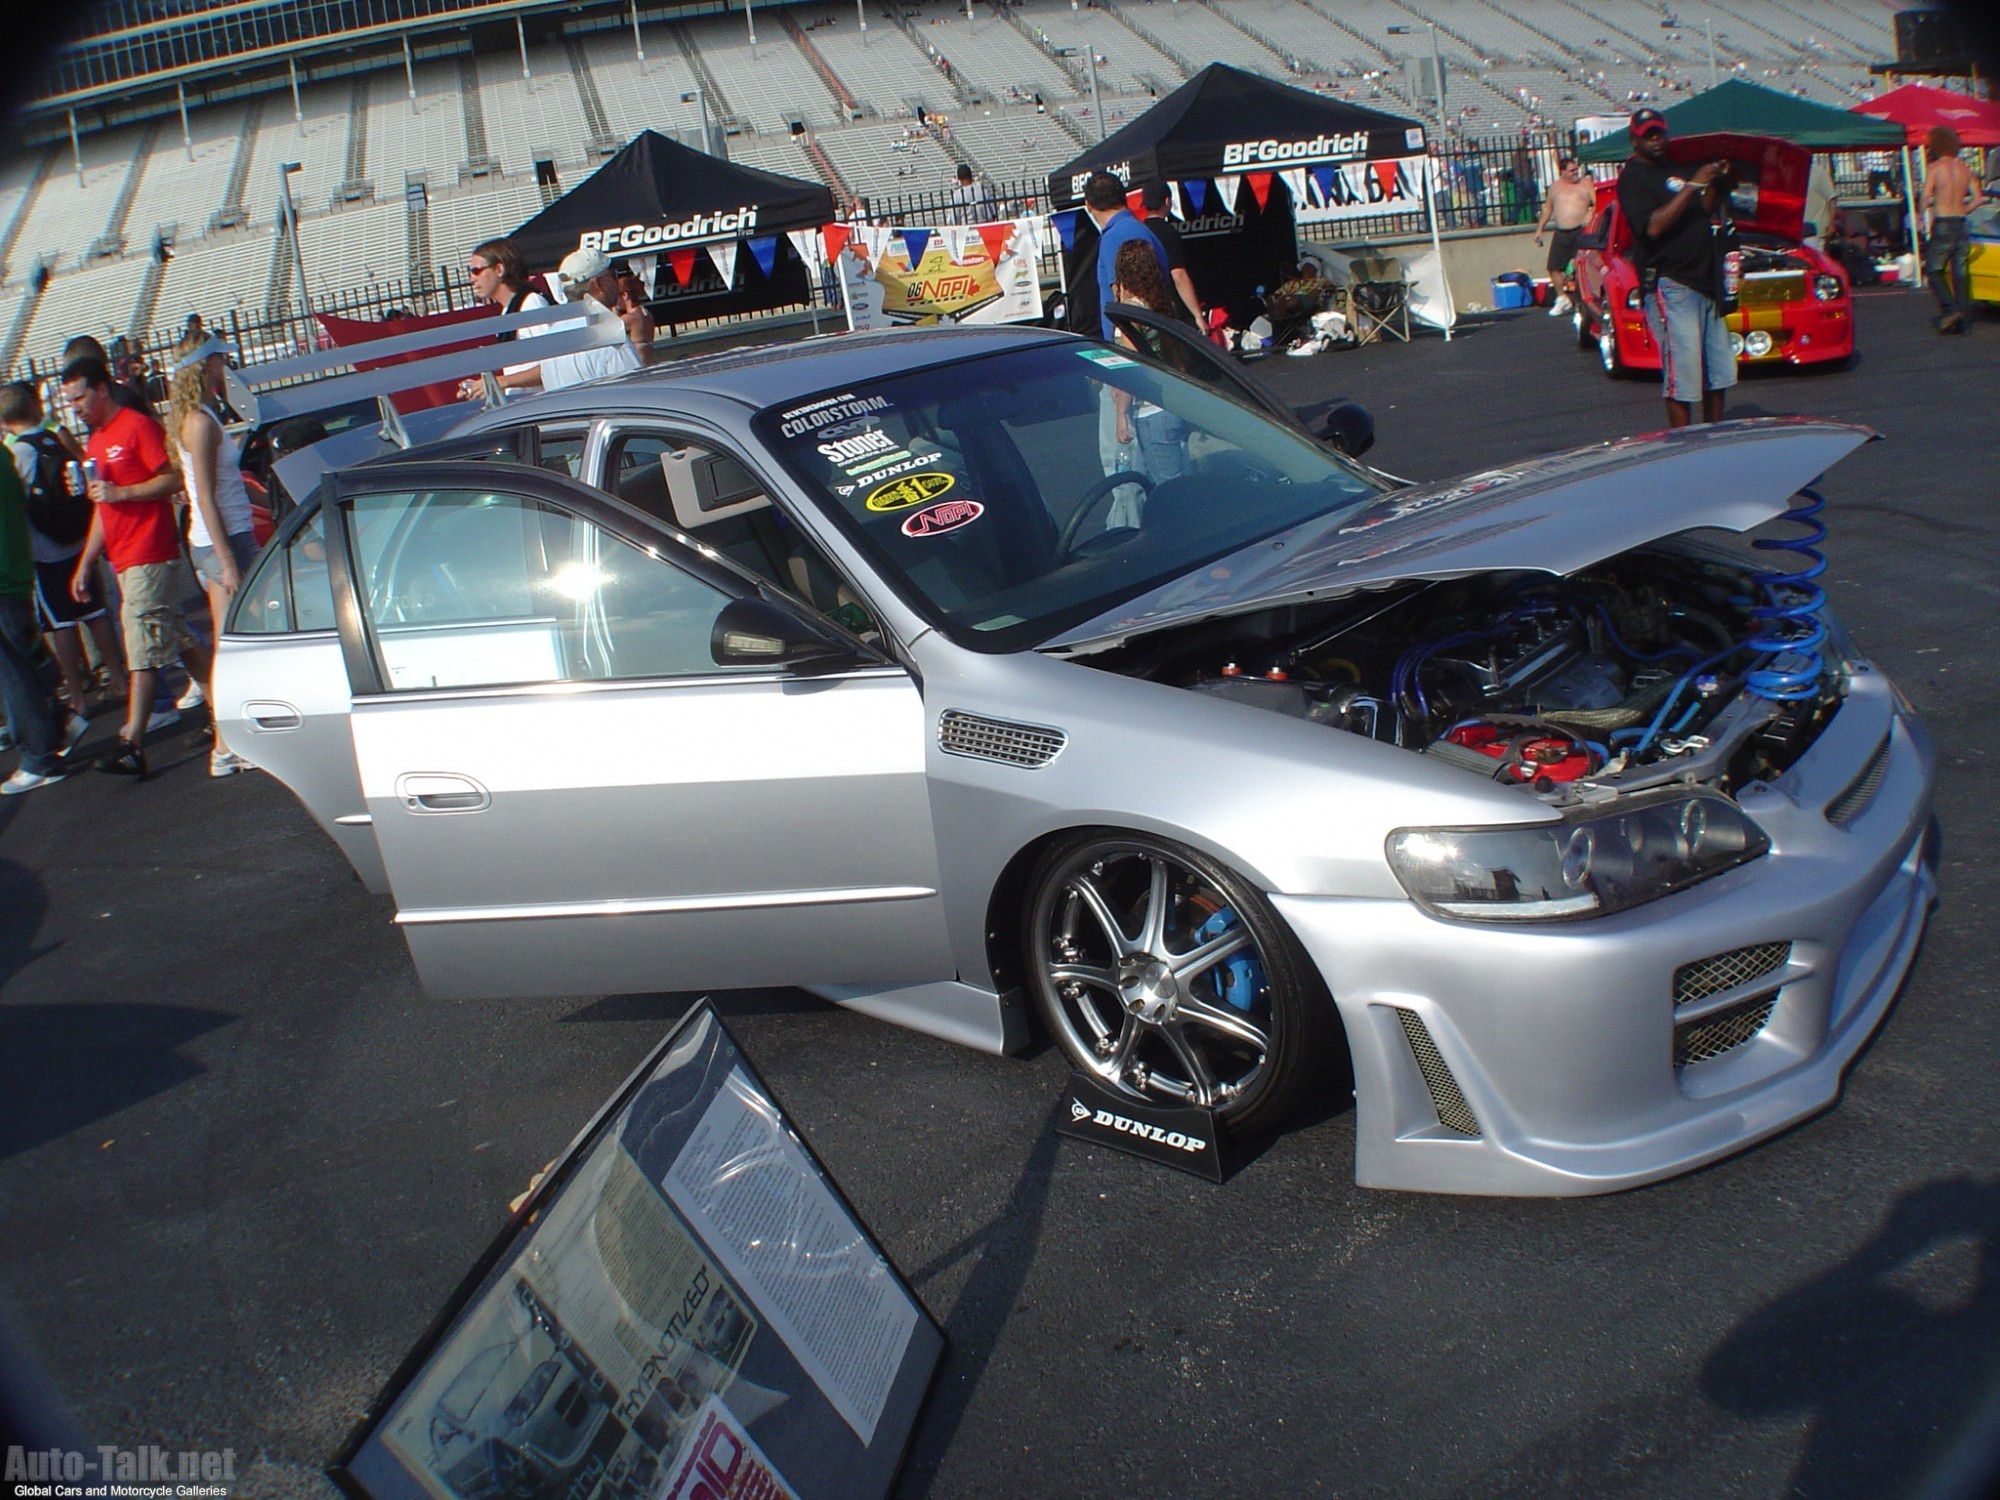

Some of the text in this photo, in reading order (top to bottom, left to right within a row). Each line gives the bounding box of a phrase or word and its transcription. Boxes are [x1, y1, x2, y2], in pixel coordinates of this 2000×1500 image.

[1223, 131, 1368, 165] BFGoodrich
[580, 206, 757, 251] BFGoodrich
[907, 275, 970, 299] 06 NOPI
[781, 396, 888, 438] COLORSTORM
[817, 429, 895, 463] Stoner
[857, 452, 942, 488] DUNLOP
[912, 501, 975, 536] NOPI
[1093, 1109, 1206, 1153] DUNLOP
